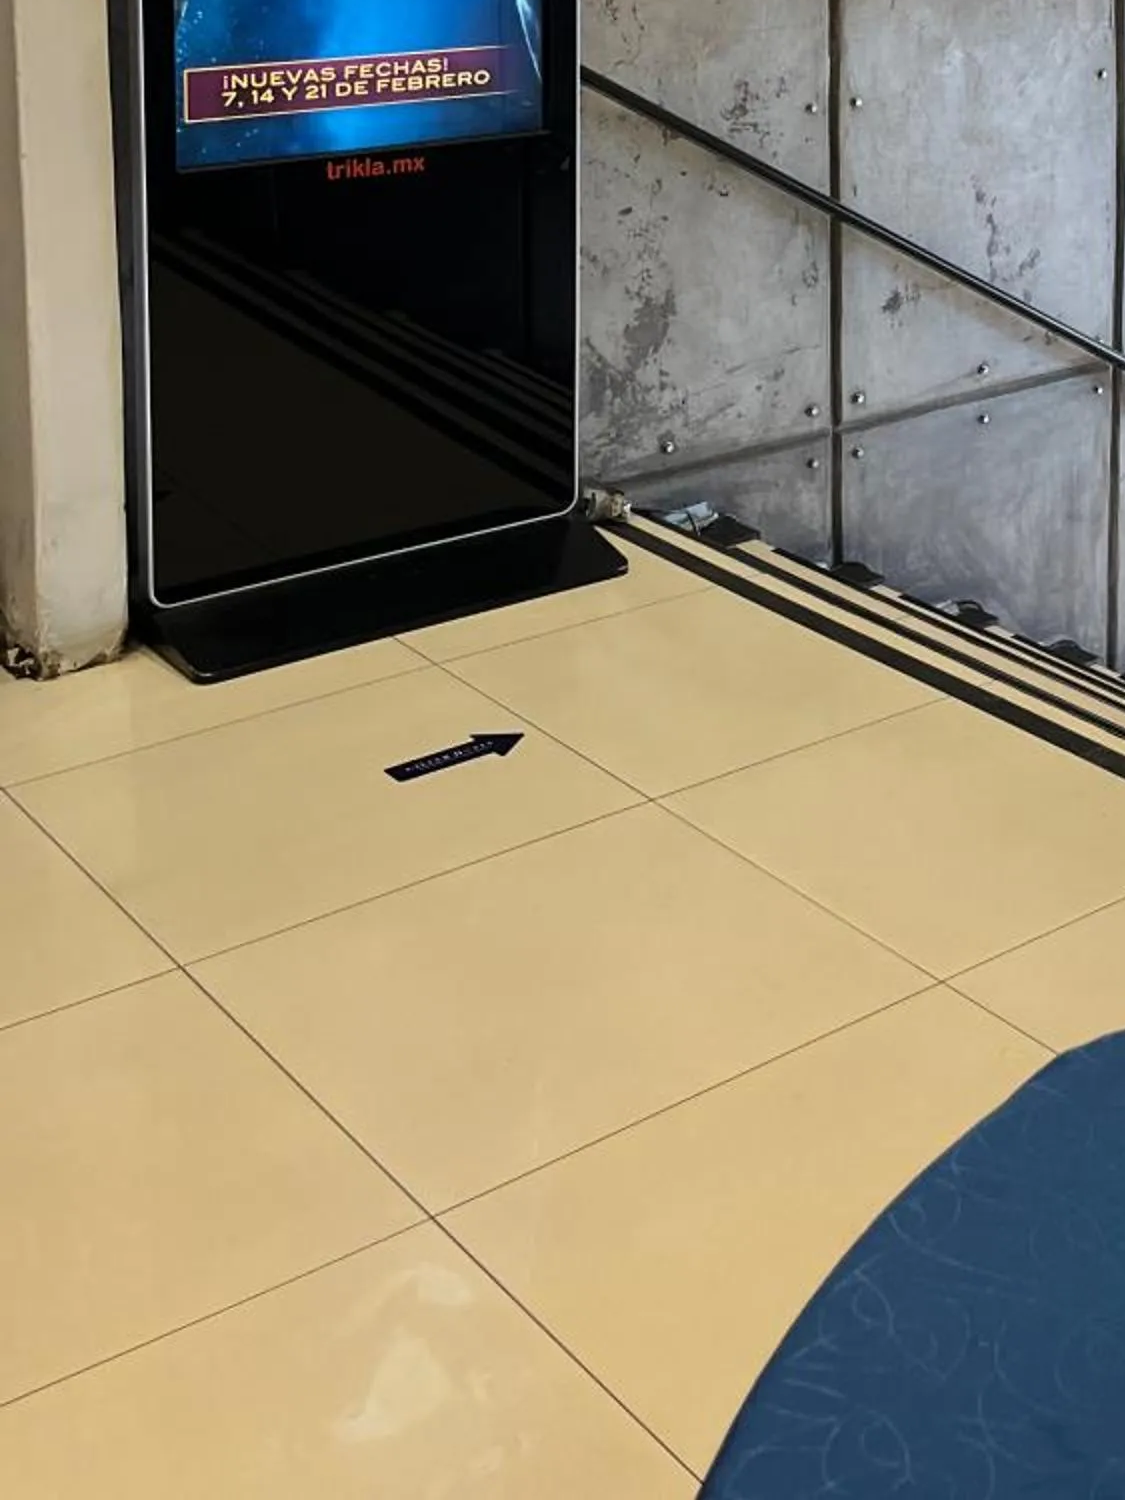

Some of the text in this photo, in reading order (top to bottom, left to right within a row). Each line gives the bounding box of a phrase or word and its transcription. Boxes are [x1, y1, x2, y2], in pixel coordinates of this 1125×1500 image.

[221, 70, 491, 108] 7, 14 Y 21 DE FEBRERO
[222, 57, 449, 90] ¡NUEVAS FECHAS!
[326, 155, 426, 181] trikla.mx
